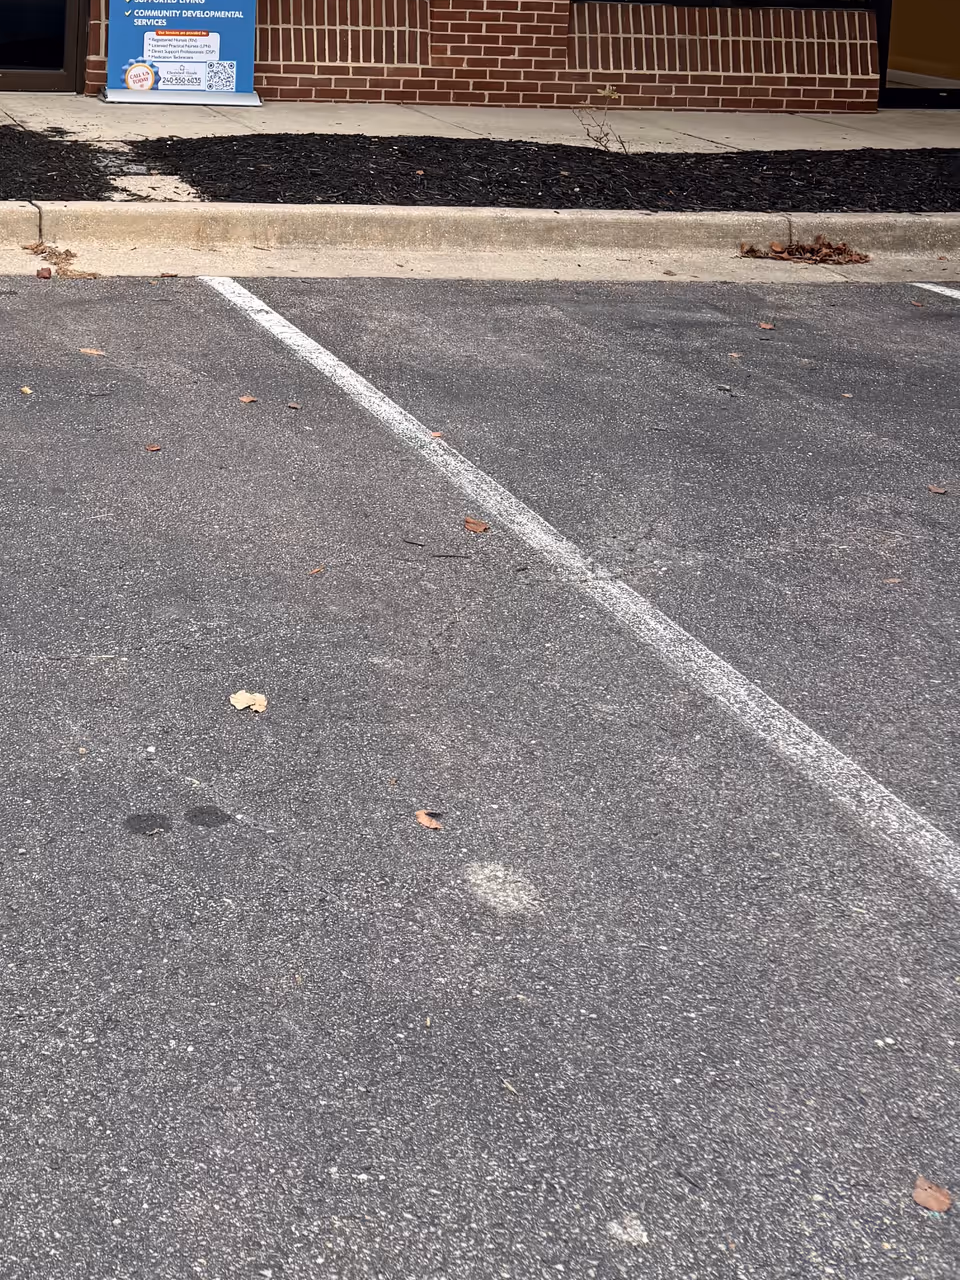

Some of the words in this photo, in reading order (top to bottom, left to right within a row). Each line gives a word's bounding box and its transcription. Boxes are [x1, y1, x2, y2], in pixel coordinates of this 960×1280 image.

[134, 9, 181, 18] COMMUNITY
[182, 10, 244, 19] DEVELOPMENTAL
[133, 18, 167, 26] SERVICES
[129, 72, 142, 80] CALL
[132, 77, 149, 85] TODAY
